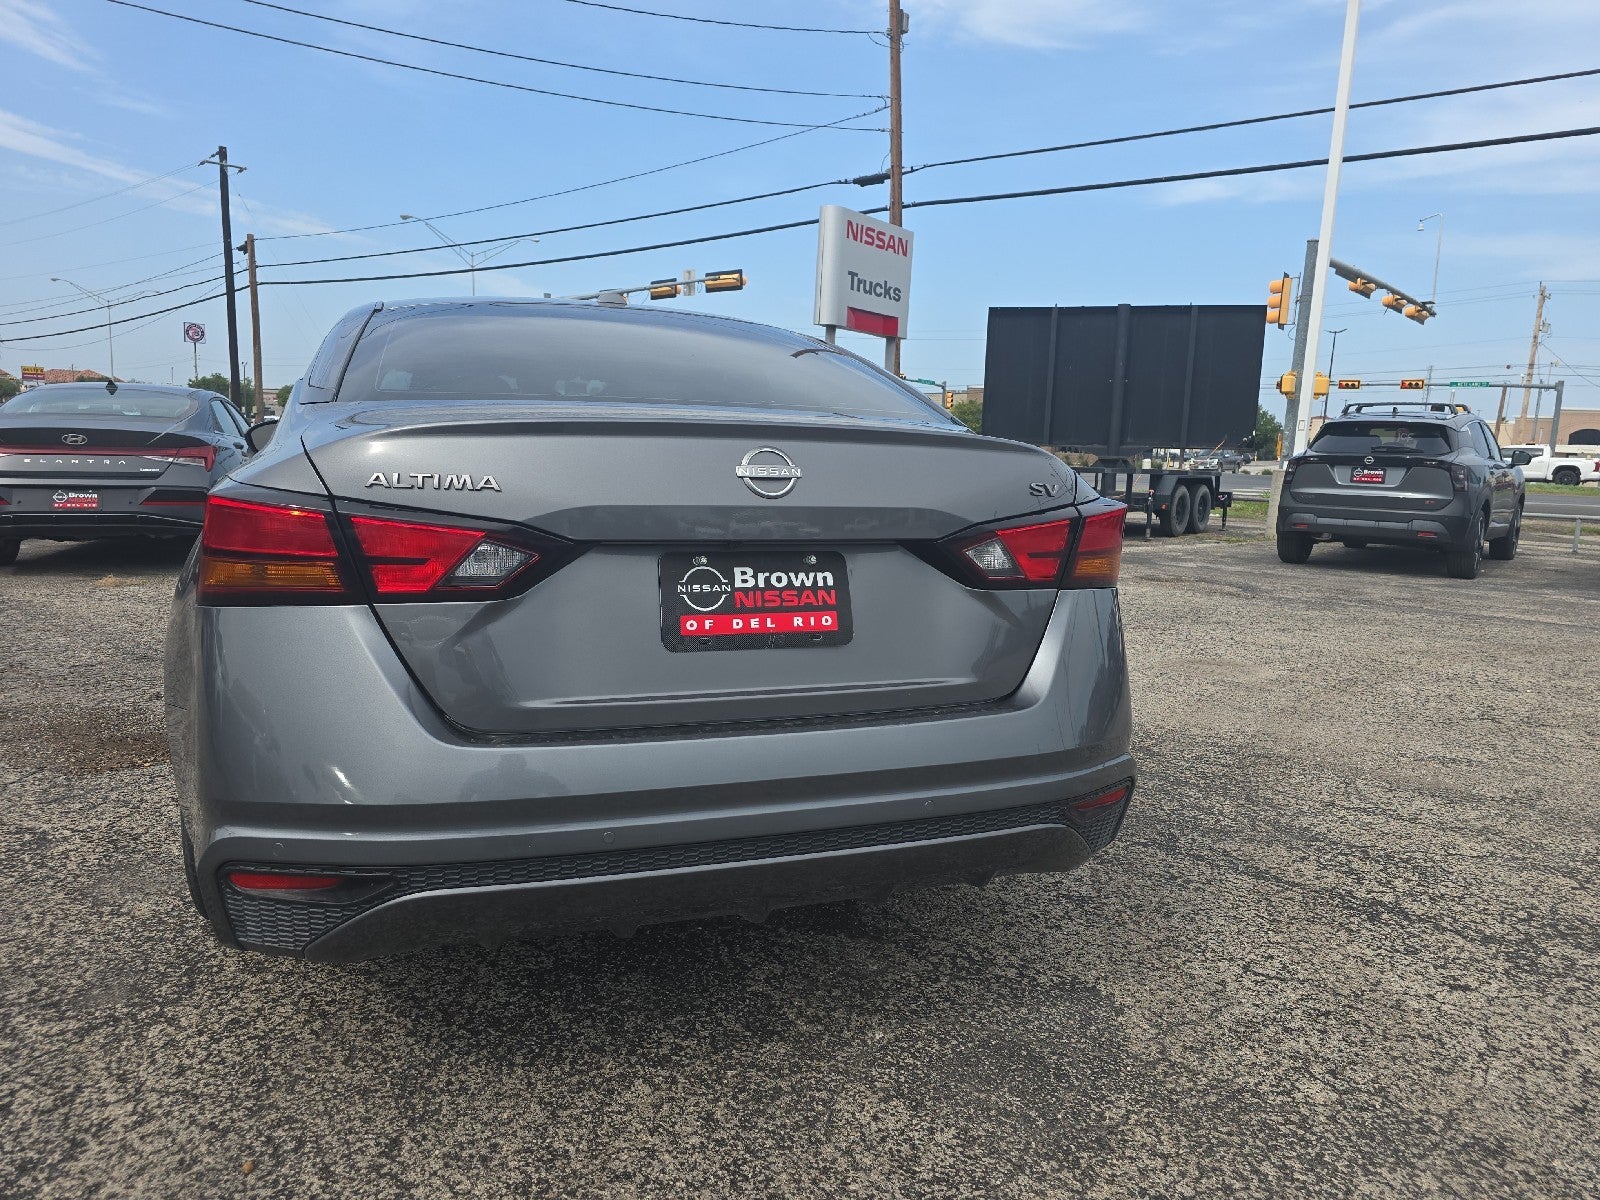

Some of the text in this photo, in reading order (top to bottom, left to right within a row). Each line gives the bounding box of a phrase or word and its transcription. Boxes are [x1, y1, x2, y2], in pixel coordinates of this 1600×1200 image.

[846, 220, 908, 257] NISSAN
[847, 270, 902, 302] Trucks
[737, 467, 802, 477] NISSAN
[364, 472, 502, 492] ALTIMA
[1029, 482, 1059, 498] SV
[733, 566, 834, 588] Brown
[677, 583, 732, 593] NISSAN
[734, 589, 837, 608] NISSAN
[685, 615, 833, 631] OF DEL RIO
